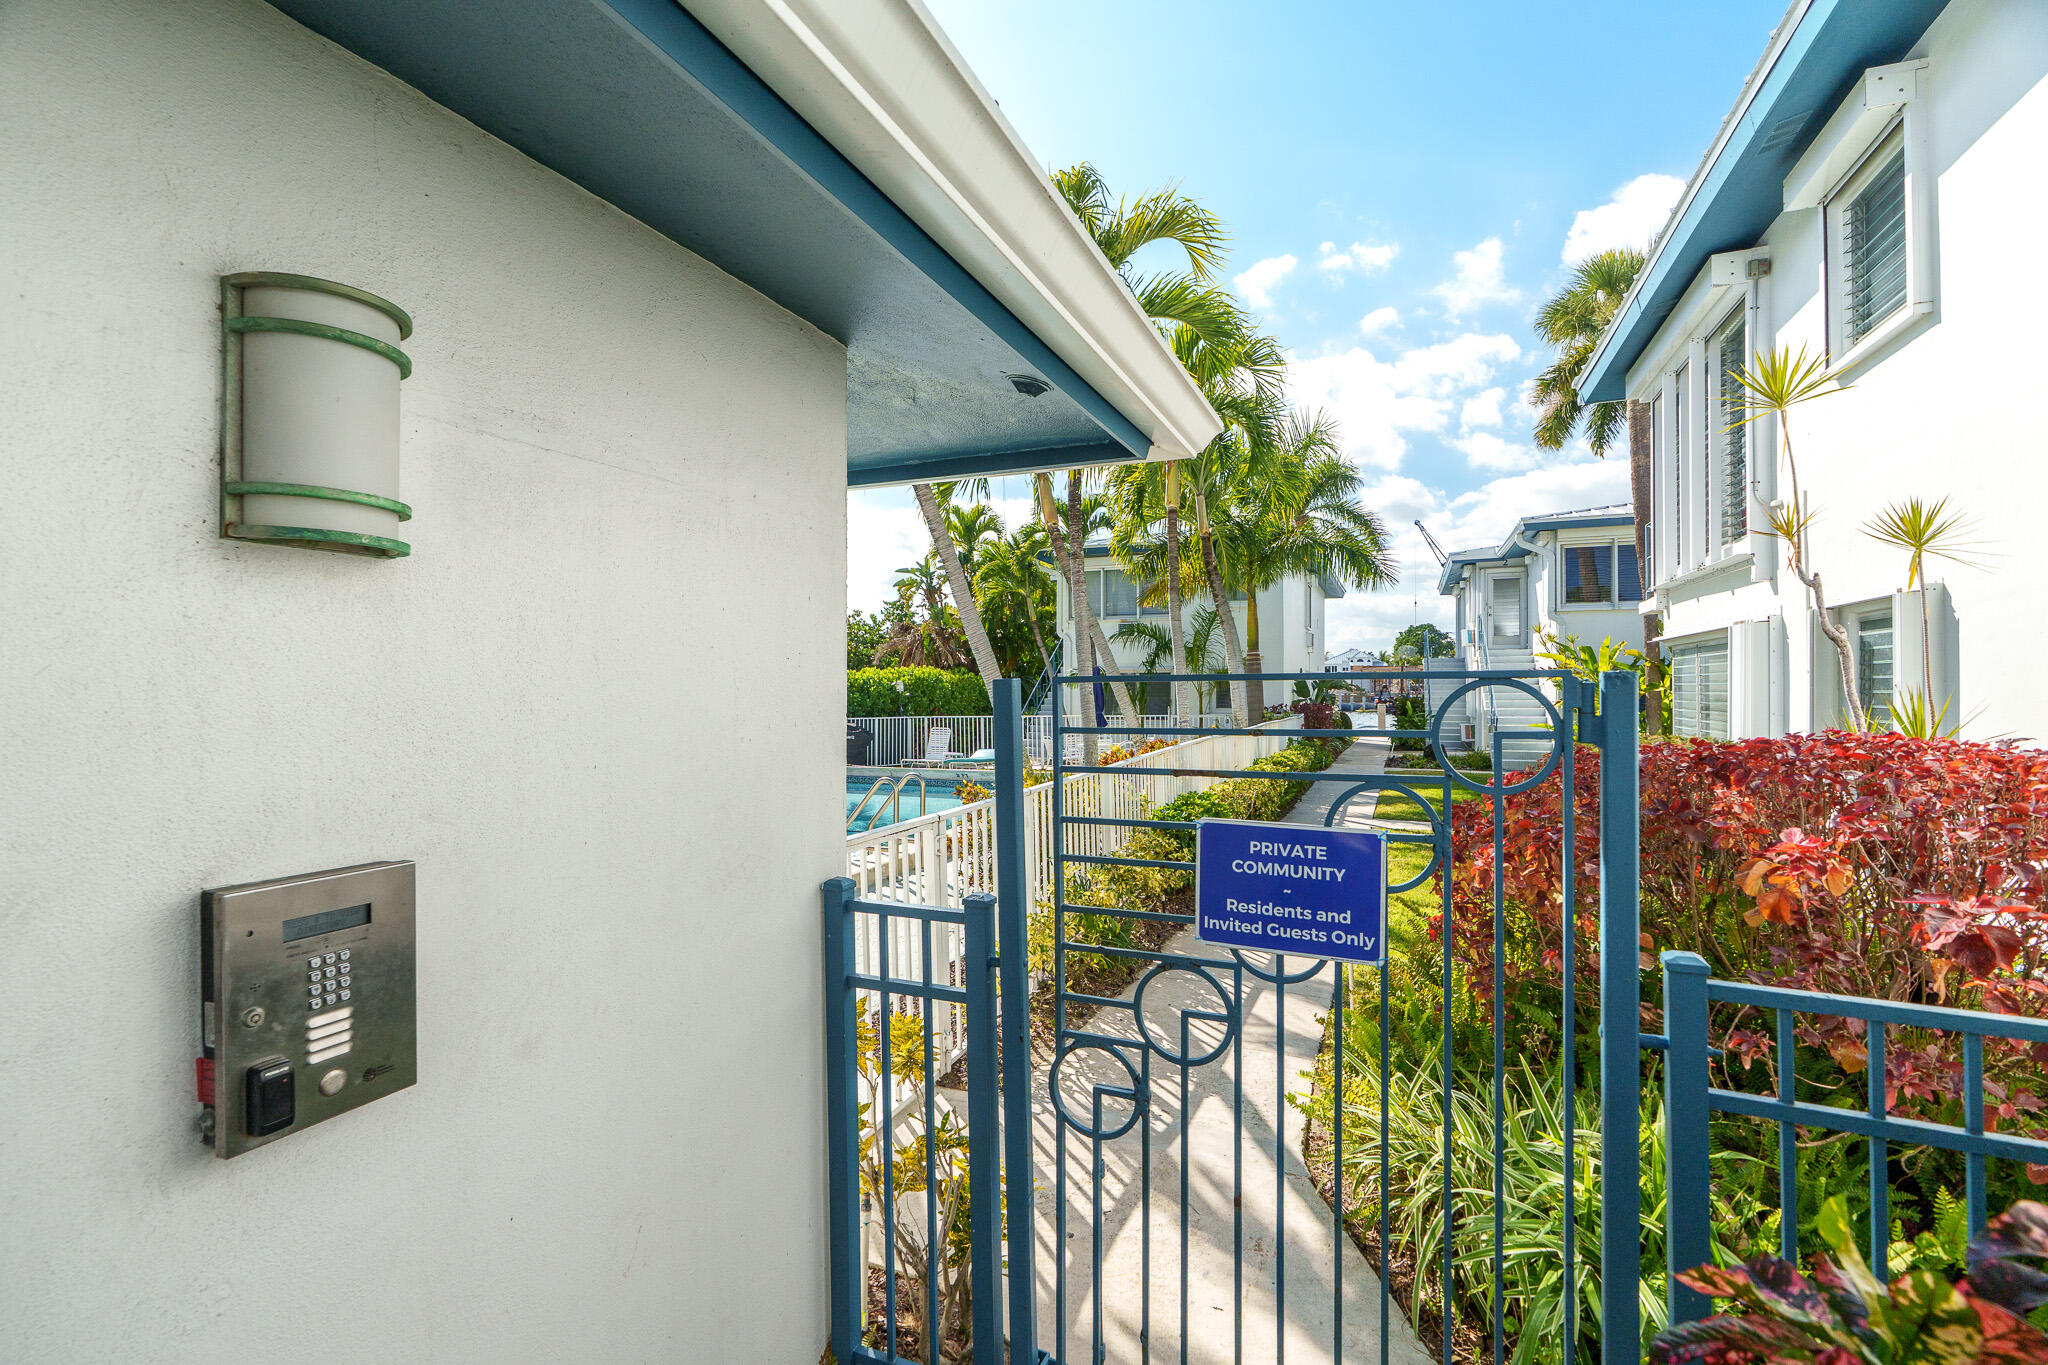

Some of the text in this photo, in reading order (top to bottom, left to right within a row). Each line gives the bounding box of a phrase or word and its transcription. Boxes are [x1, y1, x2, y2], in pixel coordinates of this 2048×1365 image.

[1249, 841, 1327, 860] PRIVATE
[1231, 859, 1346, 882] COMMUNITY
[1226, 898, 1351, 924] Residents and
[1204, 915, 1376, 951] Invited Guests Only
